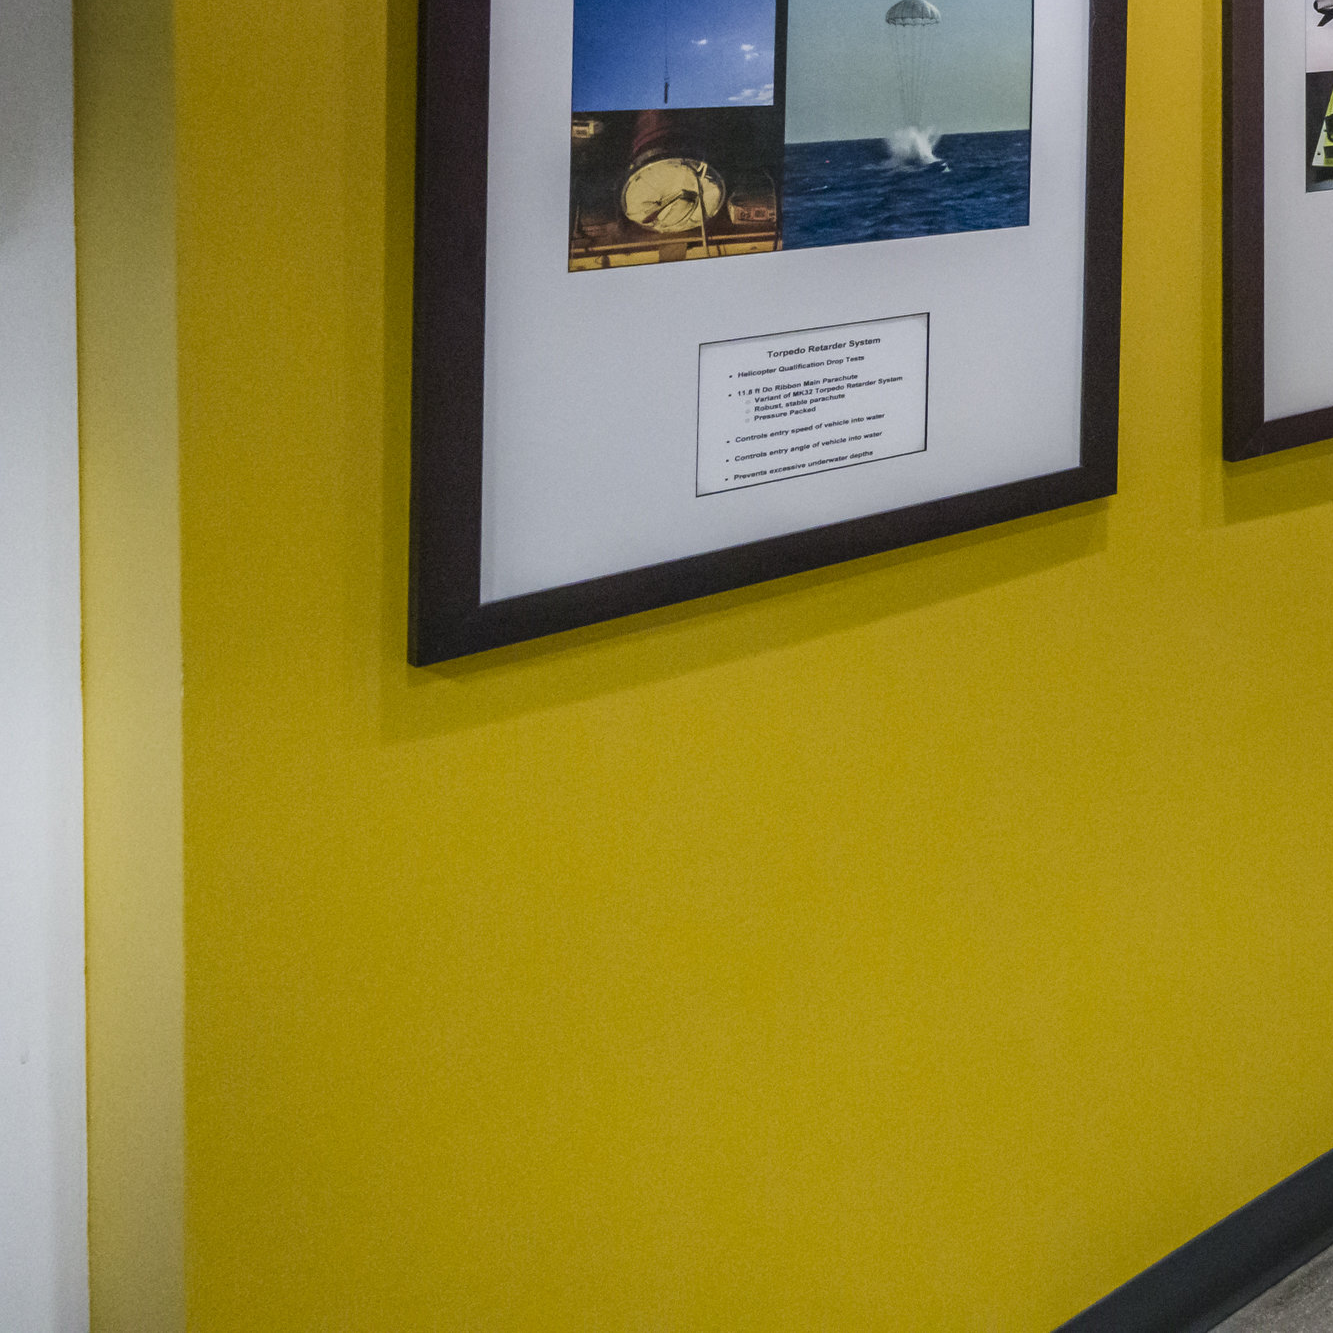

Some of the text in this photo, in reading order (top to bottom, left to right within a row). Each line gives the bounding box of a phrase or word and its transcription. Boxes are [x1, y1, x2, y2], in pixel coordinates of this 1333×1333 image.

[767, 338, 881, 358] Torpedo Retarder System
[738, 369, 777, 378] Helicopter
[779, 362, 824, 372] Qualification
[775, 383, 801, 391] Ribbon
[823, 375, 858, 383] Parachute
[755, 395, 781, 403] Variant
[793, 389, 812, 397] MK32
[816, 385, 844, 393] Torpedo
[810, 394, 845, 404] parachute
[754, 407, 816, 421] Pressure Packed
[736, 433, 767, 443] Controls
[791, 425, 813, 433] speed
[824, 420, 849, 428] vehicle
[735, 452, 767, 461] Controls
[791, 444, 810, 452] angle
[822, 438, 846, 446] vehicle
[734, 451, 873, 480] Prevents excessive underwater depths
